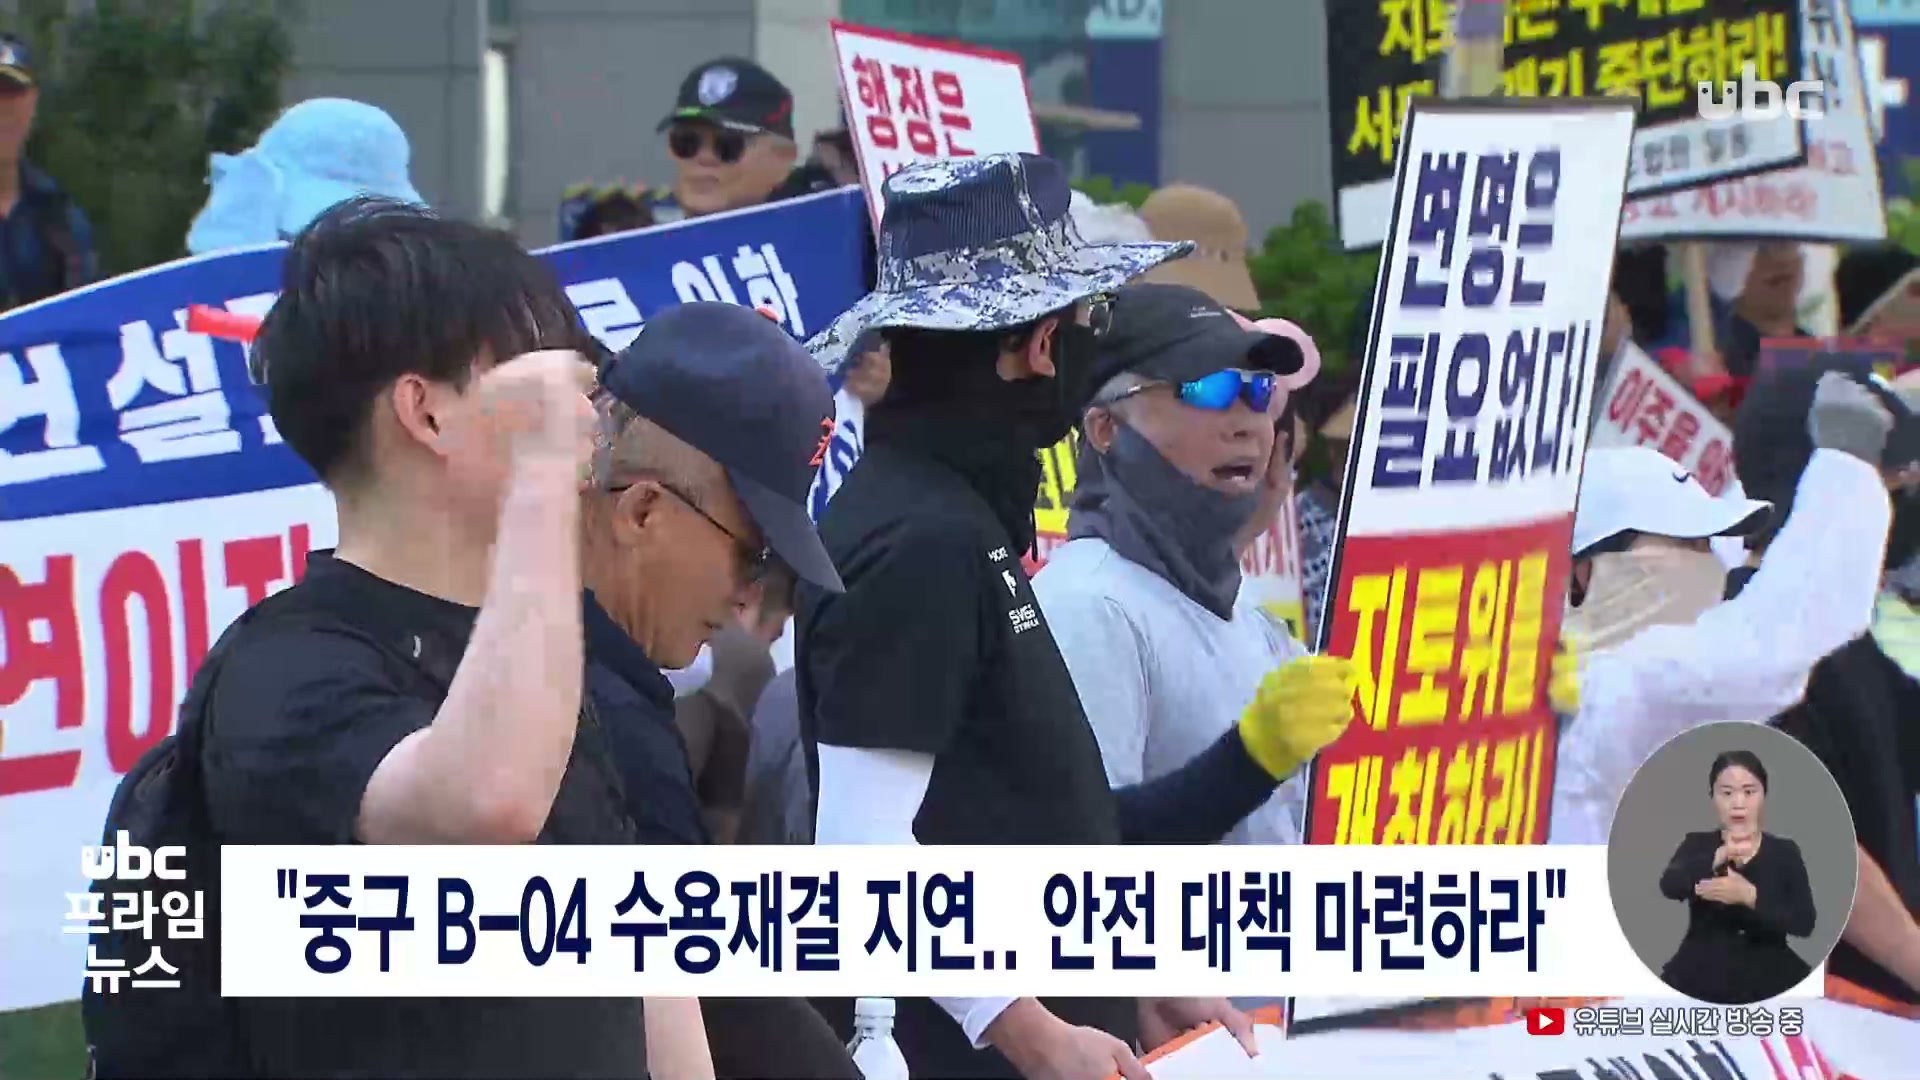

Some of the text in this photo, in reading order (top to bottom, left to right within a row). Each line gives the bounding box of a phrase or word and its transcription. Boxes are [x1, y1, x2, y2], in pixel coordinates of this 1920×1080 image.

[852, 53, 976, 156] 행정은
[1400, 147, 1561, 309] 변명은
[1371, 319, 1592, 490] 필요없다!
[1348, 551, 1548, 732] 지토위를
